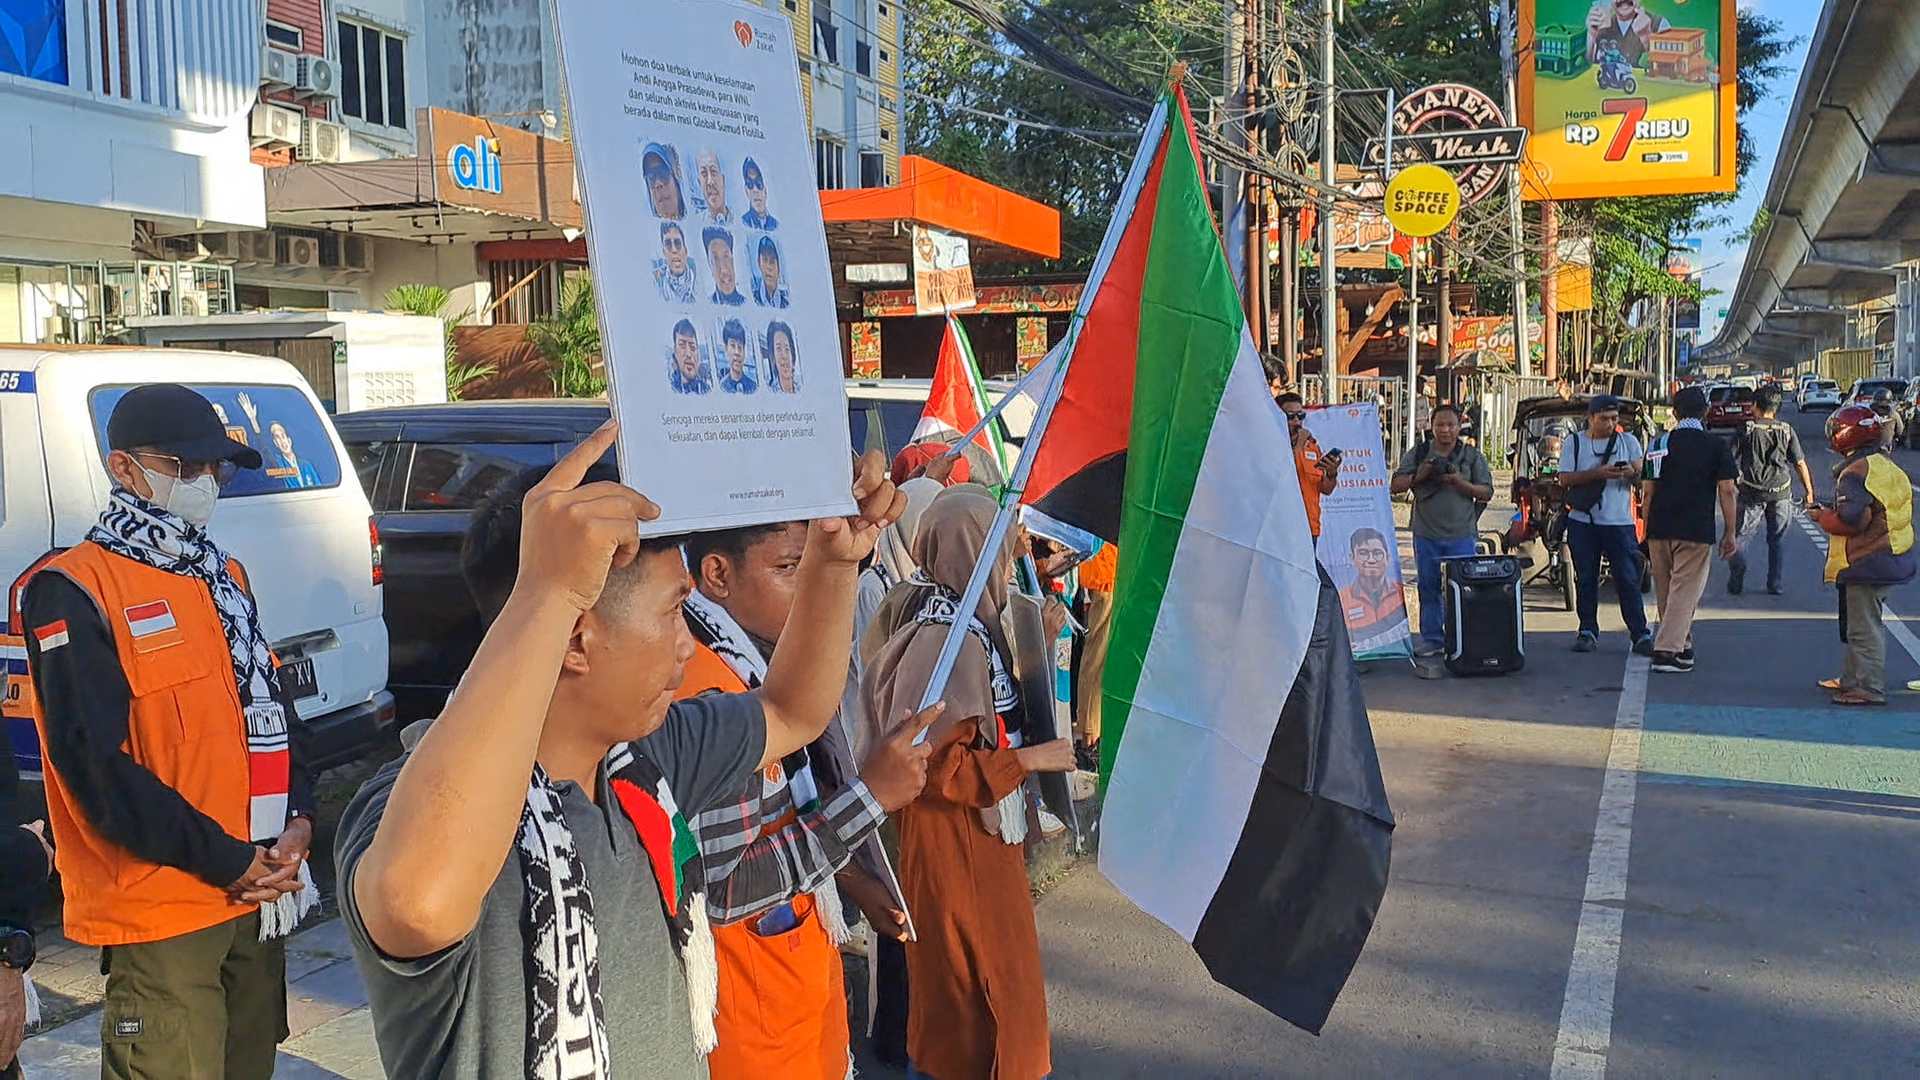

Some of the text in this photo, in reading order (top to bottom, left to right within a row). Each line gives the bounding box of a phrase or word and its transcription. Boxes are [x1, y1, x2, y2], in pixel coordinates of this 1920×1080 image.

[621, 50, 756, 92] Mohon doa terbaik untuk keselamatan
[634, 72, 651, 85] Andi
[653, 76, 676, 93] Angga
[624, 104, 651, 118] berada
[652, 109, 676, 123] dalam
[676, 115, 692, 126] misi
[692, 116, 716, 130] Global
[717, 121, 740, 135] Sumud
[628, 88, 760, 126] dan seluruh aktivis kemanusiaan yang
[1394, 88, 1496, 131] PLANET
[1565, 110, 1598, 120] Harga
[1565, 123, 1599, 146] Rp
[1602, 97, 1648, 162] 7
[1635, 119, 1690, 139] RIBU
[1432, 136, 1511, 160] Wash
[447, 135, 502, 194] ali
[1394, 202, 1447, 215] SPACE
[661, 412, 692, 428] Semoga
[693, 415, 719, 425] mereka
[703, 431, 718, 441] dan
[719, 430, 737, 443] dapat
